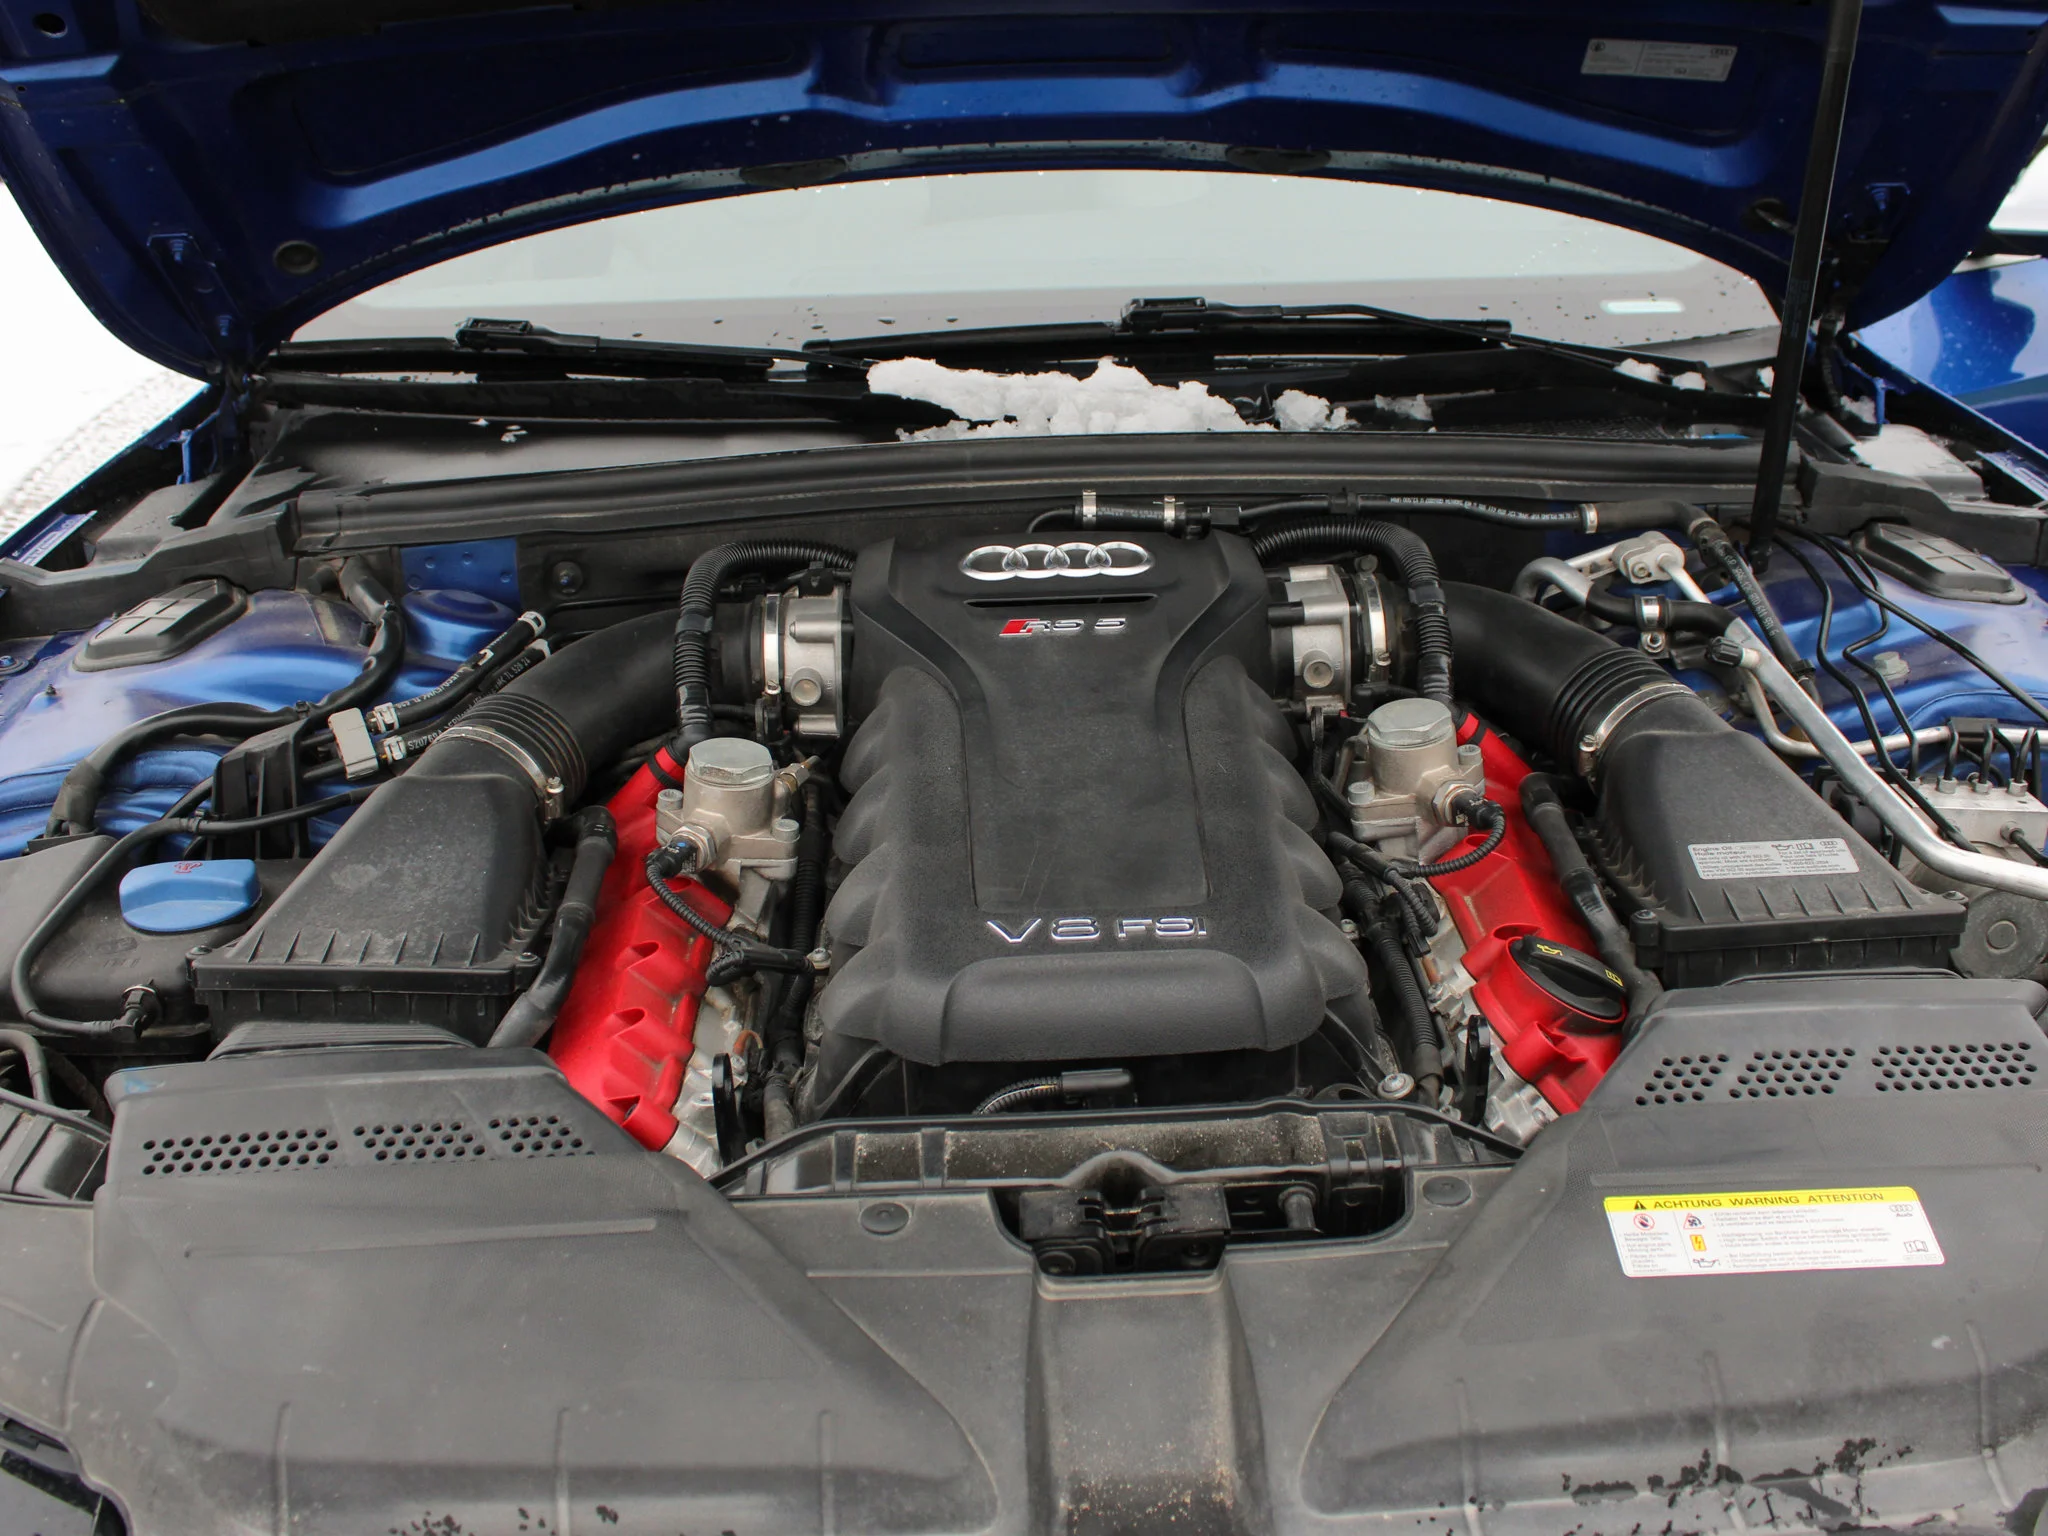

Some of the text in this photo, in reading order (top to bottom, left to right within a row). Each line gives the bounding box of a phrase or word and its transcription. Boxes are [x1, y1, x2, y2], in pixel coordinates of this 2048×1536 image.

[1004, 617, 1126, 635] RS 5
[986, 916, 1207, 943] V8 FSI
[1654, 1192, 1884, 1209] ACHTUNG WARNING ATTENTION
